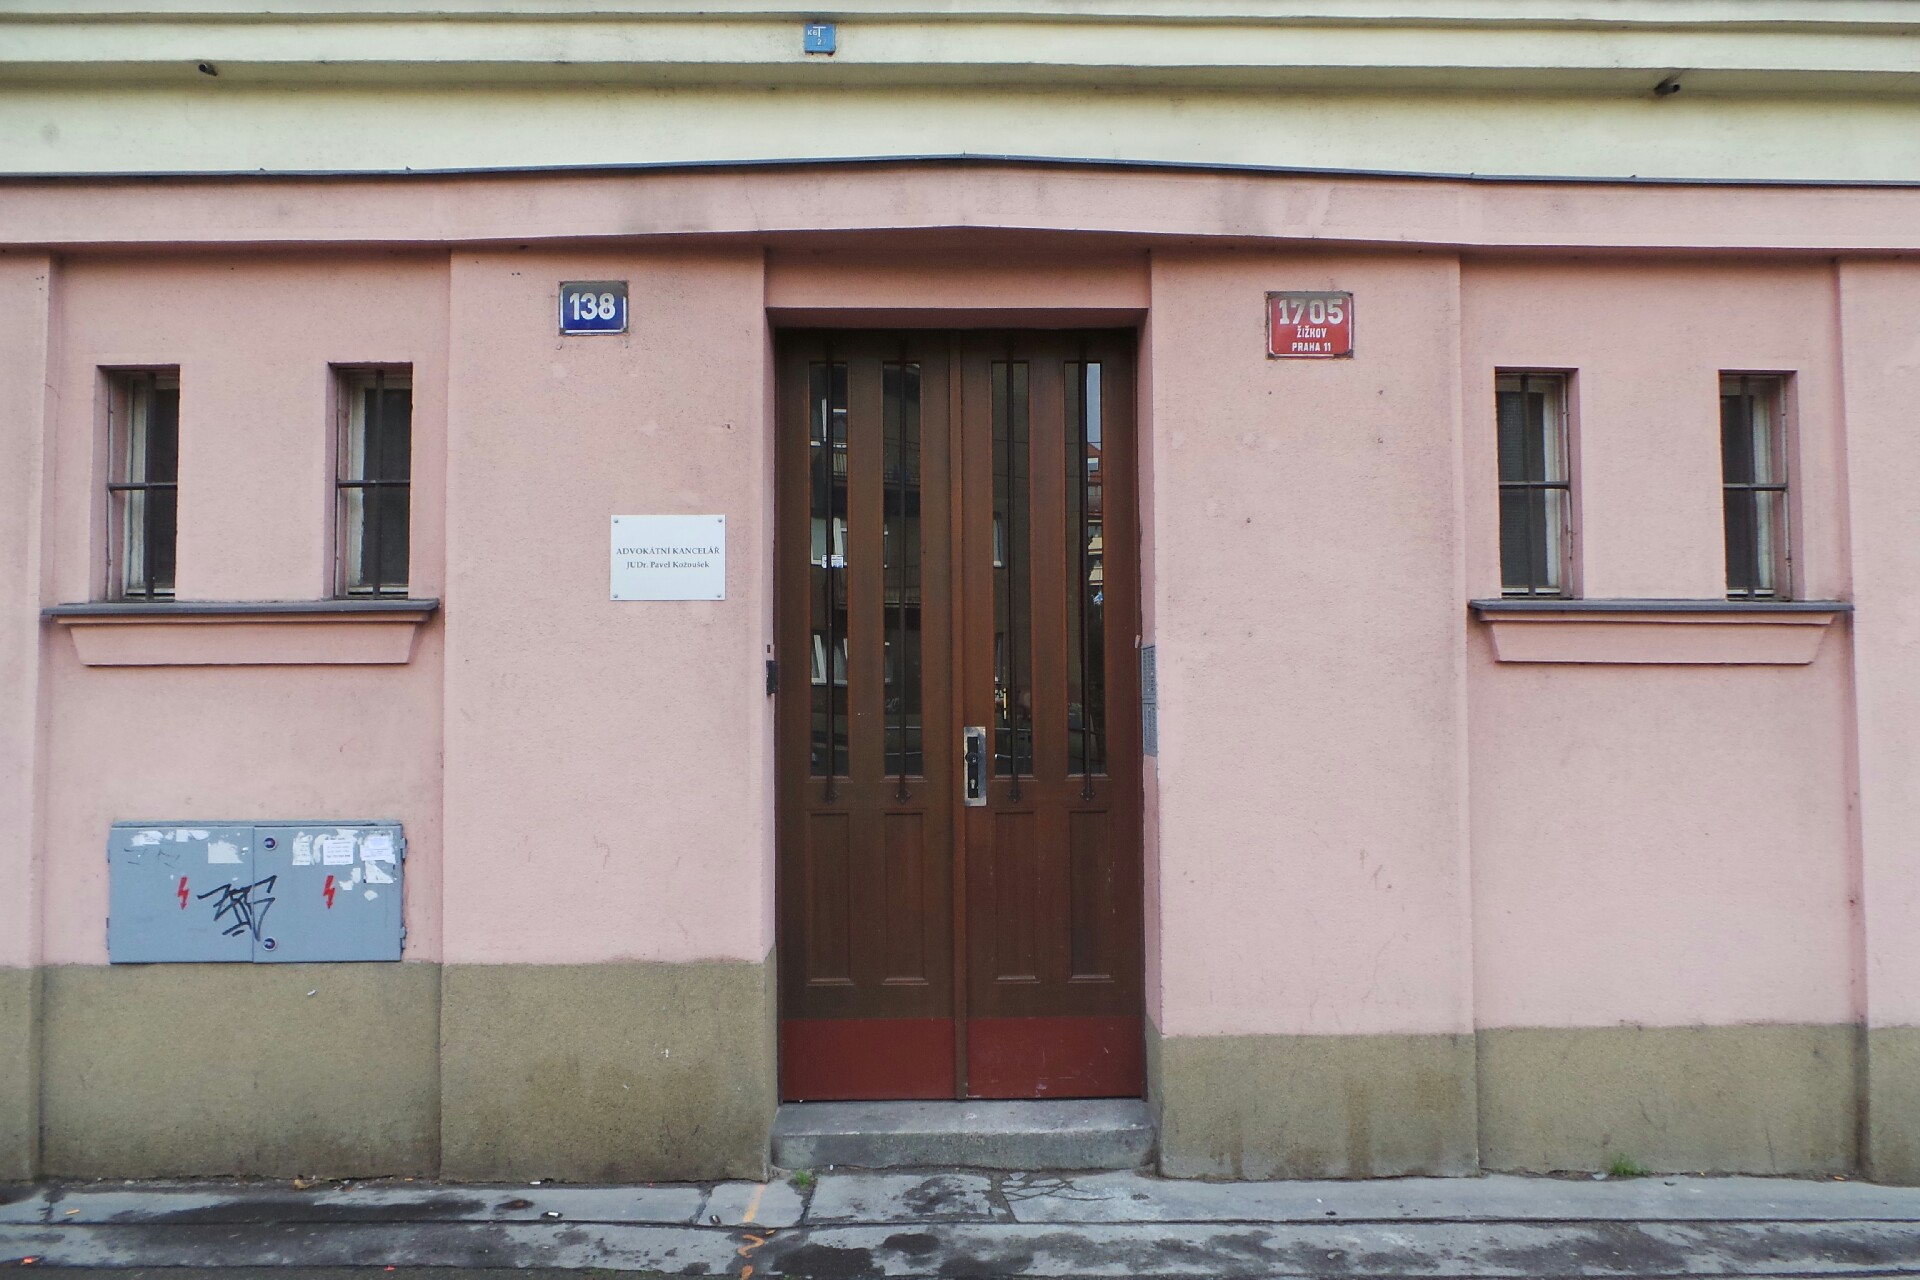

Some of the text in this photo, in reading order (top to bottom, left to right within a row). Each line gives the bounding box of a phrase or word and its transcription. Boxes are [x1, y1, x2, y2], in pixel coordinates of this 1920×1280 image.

[569, 292, 616, 320] 138
[1279, 298, 1344, 325] 1705
[1296, 325, 1327, 338] ŽIŽKOV
[1292, 342, 1332, 352] PRAHA 11
[616, 546, 720, 555] ADVOKÁTNÍ KANCELÁŘ
[626, 561, 649, 570] JUDr.
[650, 561, 671, 569] Pavel
